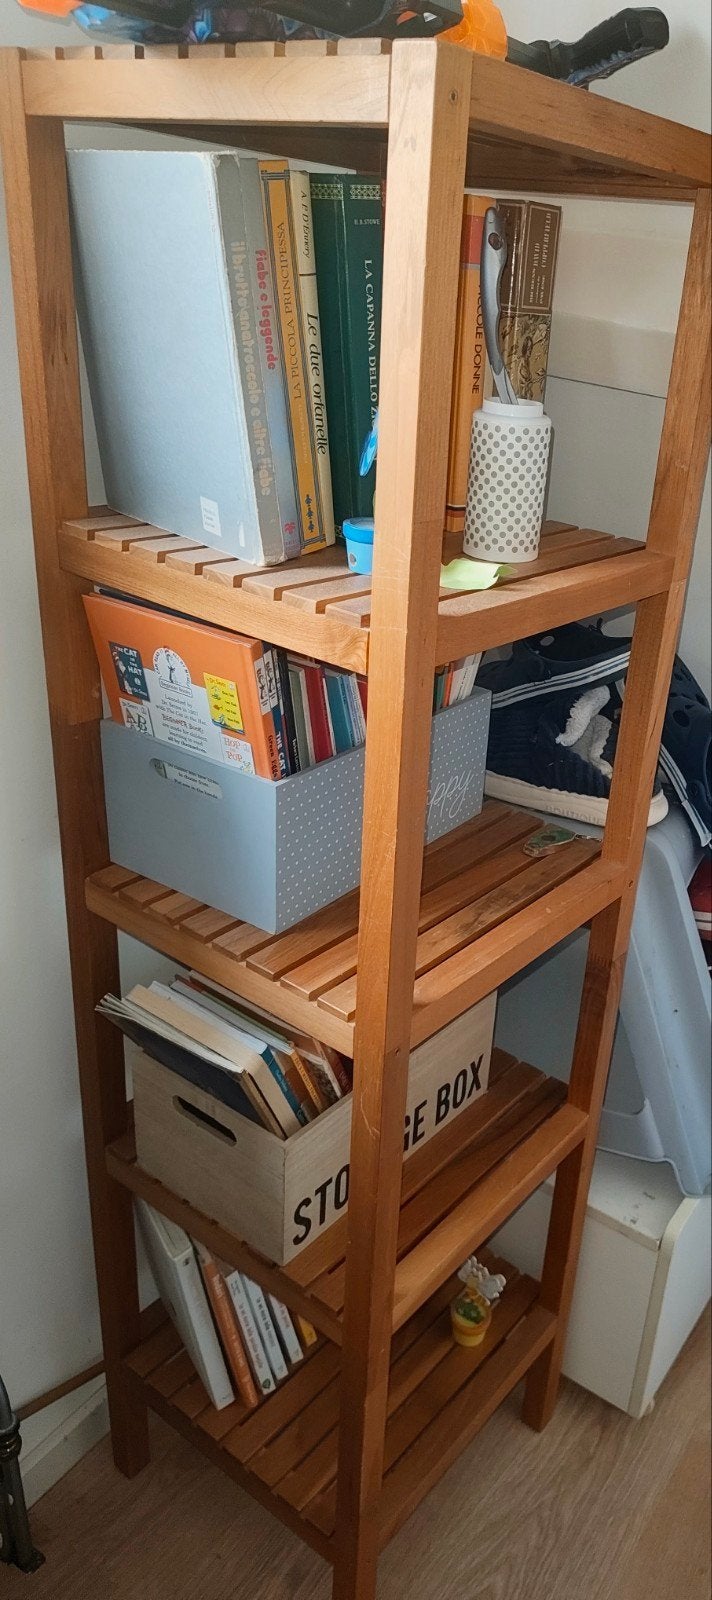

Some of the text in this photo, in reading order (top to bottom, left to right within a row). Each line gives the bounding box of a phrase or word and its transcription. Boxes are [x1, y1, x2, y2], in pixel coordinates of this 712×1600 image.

[364, 259, 374, 280] LA
[255, 249, 279, 370] fiabe e leggende
[277, 222, 302, 399] LA PICCOLA PRINCIPESSA
[365, 283, 377, 352] CAPANNA
[307, 313, 328, 455] Le due orfanelle
[368, 356, 379, 402] DELLO
[472, 344, 483, 395] DONNE
[123, 647, 138, 658] CAT
[127, 666, 143, 676] HAT
[275, 731, 284, 750] THE
[278, 752, 287, 770] CAT
[434, 1053, 485, 1127] BOX
